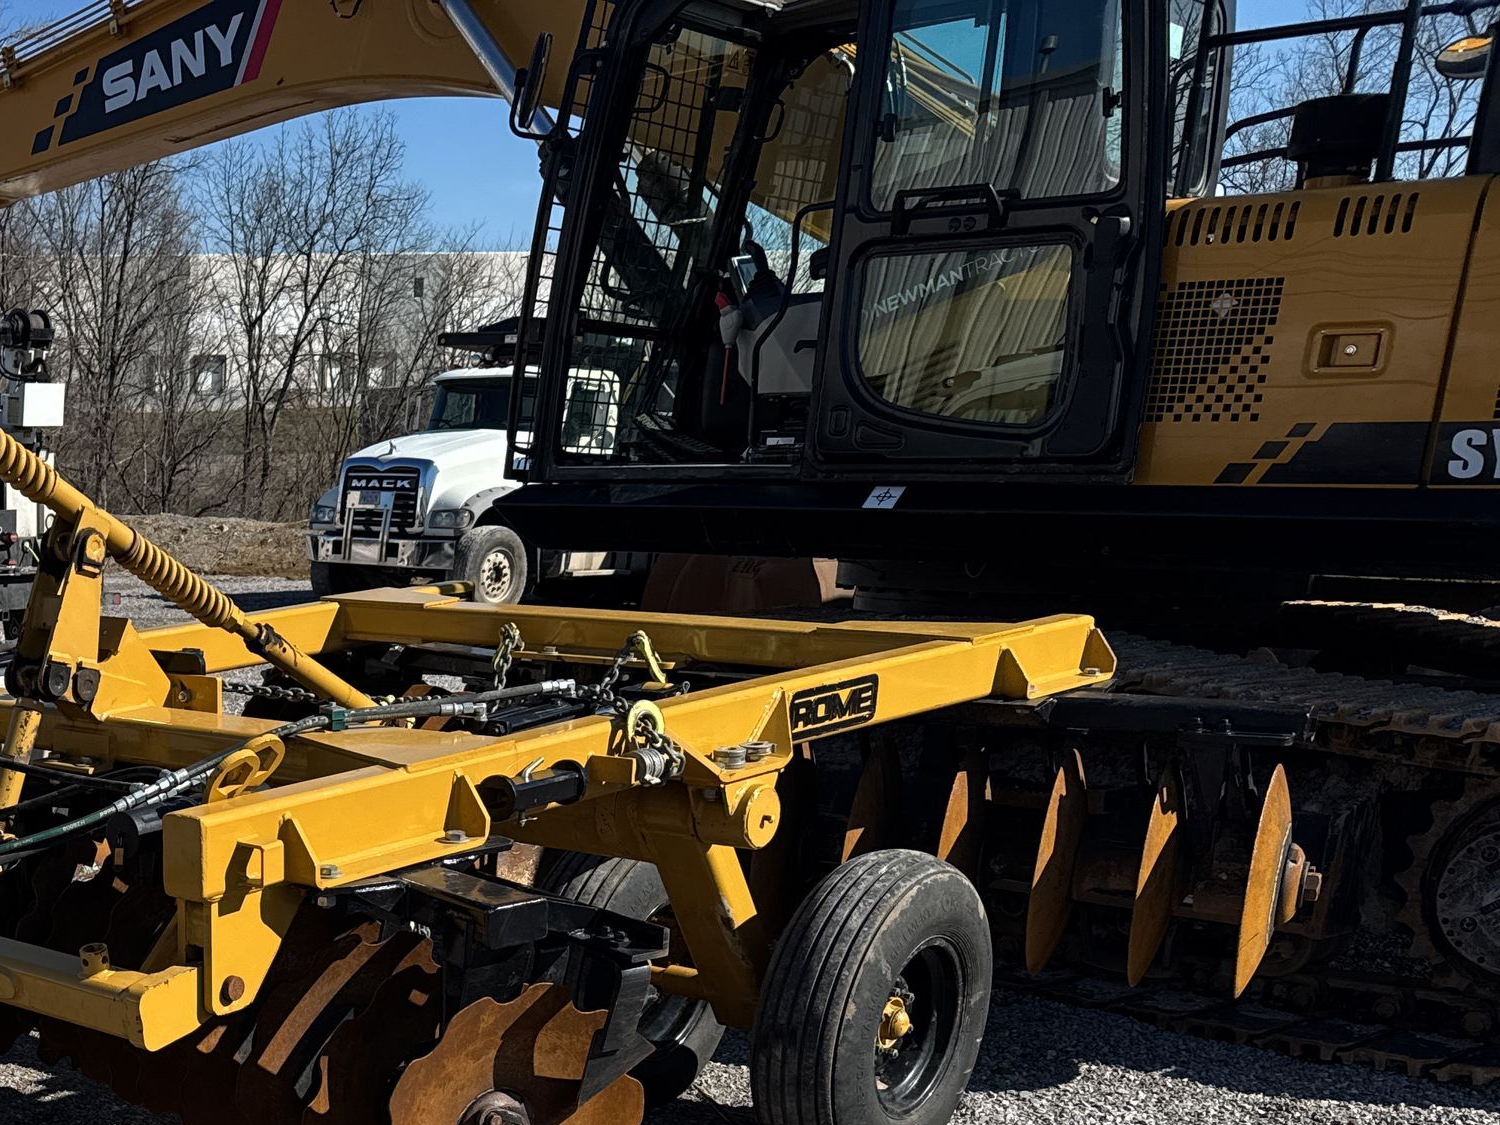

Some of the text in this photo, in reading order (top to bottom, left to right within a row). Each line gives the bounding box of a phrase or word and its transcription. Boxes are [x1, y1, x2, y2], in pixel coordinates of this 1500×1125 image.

[102, 11, 244, 114] SANY
[1447, 428, 1500, 479] S
[351, 479, 411, 488] MACK
[791, 684, 876, 731] ROME
